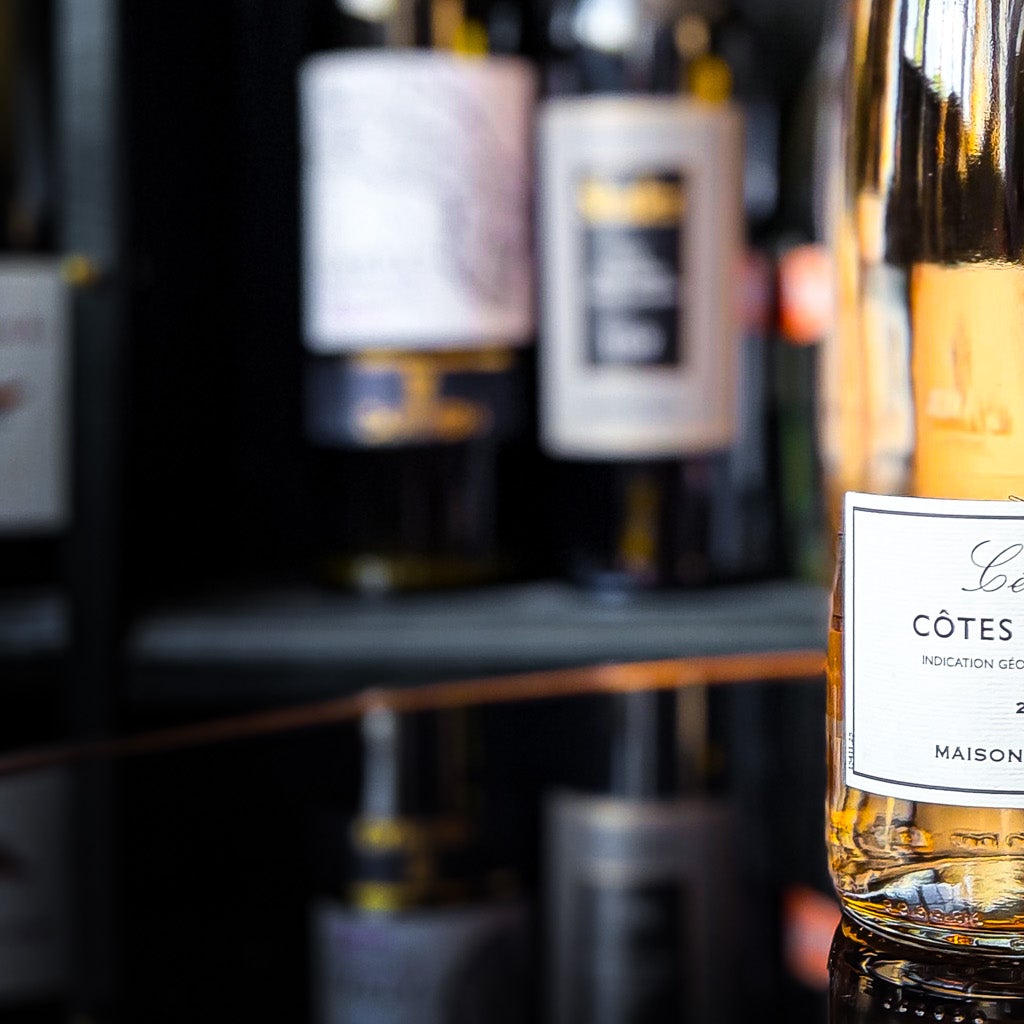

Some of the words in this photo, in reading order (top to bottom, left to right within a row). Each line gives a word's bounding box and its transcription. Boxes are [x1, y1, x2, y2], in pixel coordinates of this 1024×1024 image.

[912, 609, 1013, 642] CÔTES
[921, 654, 994, 669] INDICATION
[934, 744, 1023, 763] MAISON
